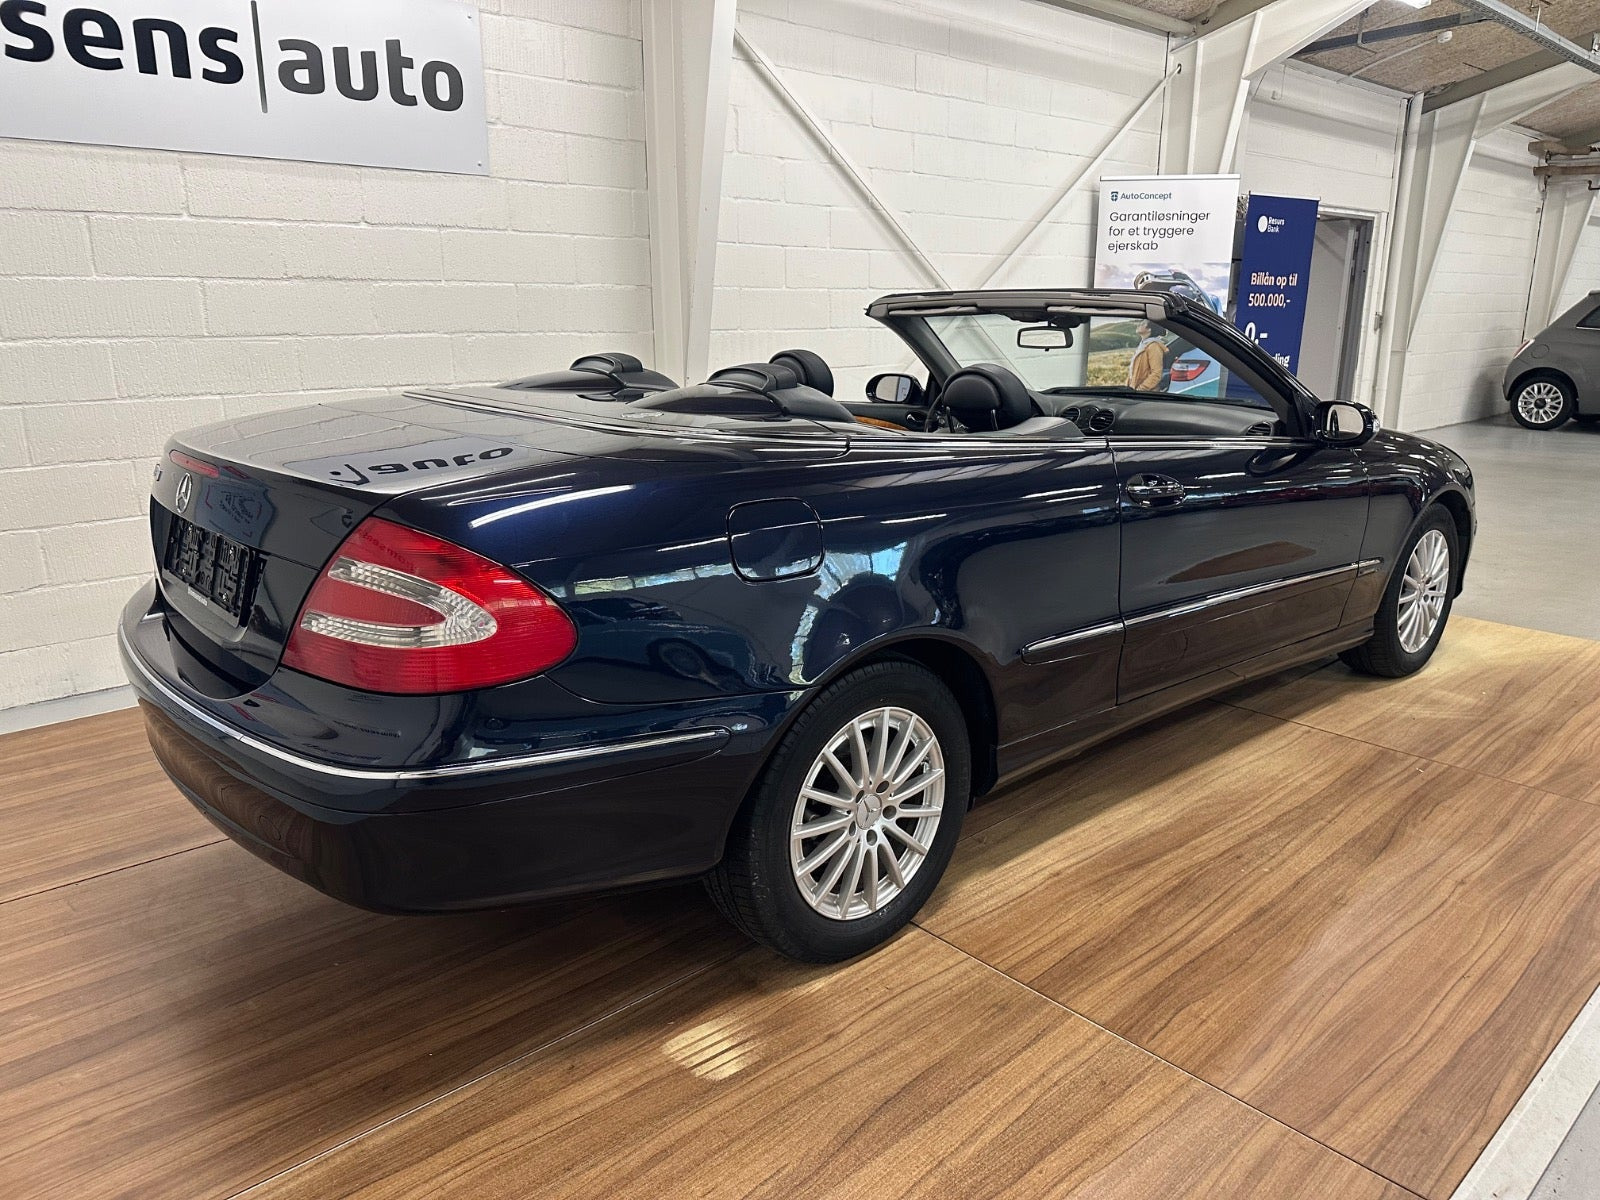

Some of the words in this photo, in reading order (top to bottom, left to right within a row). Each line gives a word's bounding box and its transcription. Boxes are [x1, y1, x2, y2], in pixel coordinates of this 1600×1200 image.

[277, 38, 464, 112] auto
[1120, 192, 1172, 201] AutoConcept
[1109, 210, 1211, 224] Garantiløsninger
[1108, 226, 1125, 237] for
[1128, 226, 1140, 236] et
[1143, 226, 1194, 239] tryggere
[1267, 225, 1280, 233] Bank
[1107, 240, 1159, 254] ejerskab
[1250, 271, 1275, 286] Billån
[1276, 276, 1287, 290] op
[1289, 273, 1298, 287] til
[1248, 293, 1291, 309] 500.000,-
